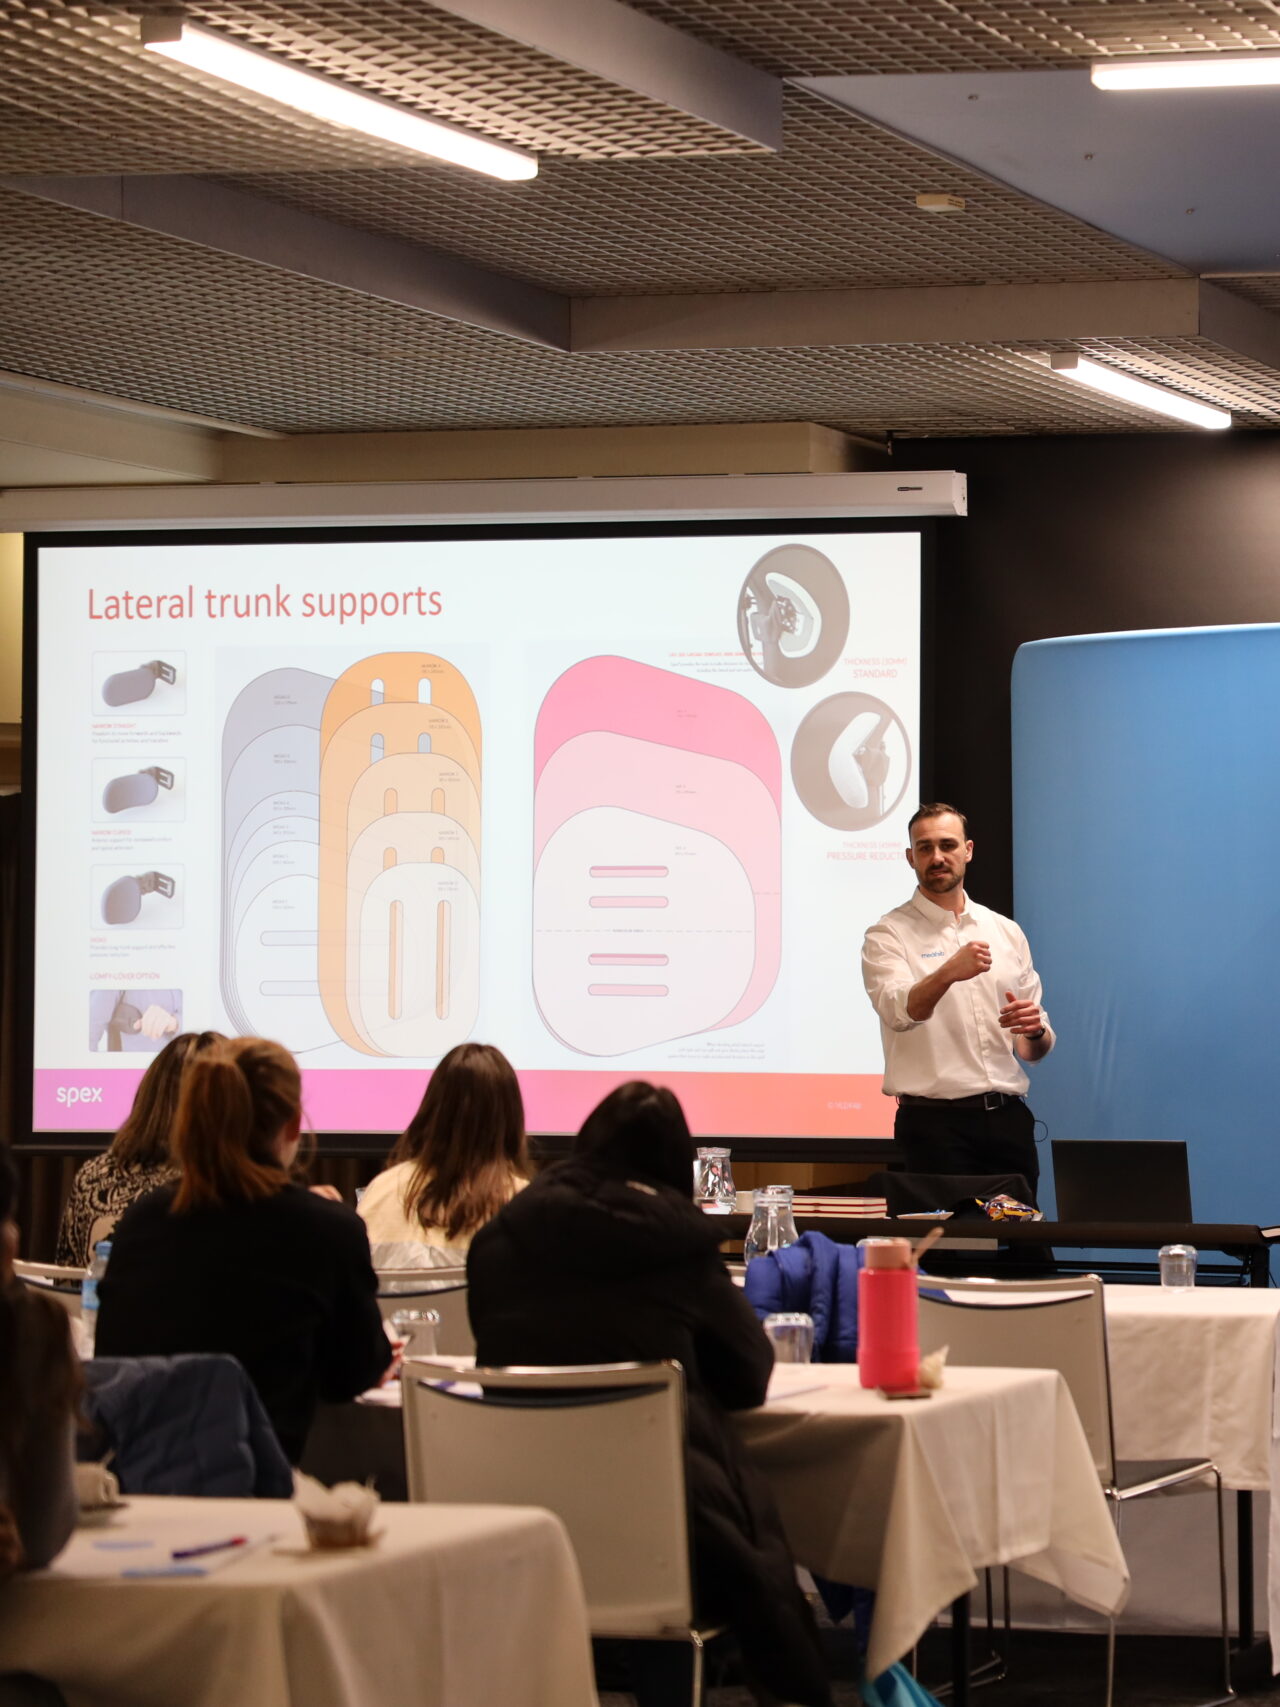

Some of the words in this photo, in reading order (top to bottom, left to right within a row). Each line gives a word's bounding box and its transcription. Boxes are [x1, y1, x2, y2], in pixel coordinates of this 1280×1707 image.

[88, 585, 194, 621] Lateral
[205, 584, 292, 619] trunk
[301, 586, 443, 625] supports
[853, 668, 898, 679] STANDARD
[826, 851, 868, 861] PRESSURE
[56, 1086, 103, 1107] spex
